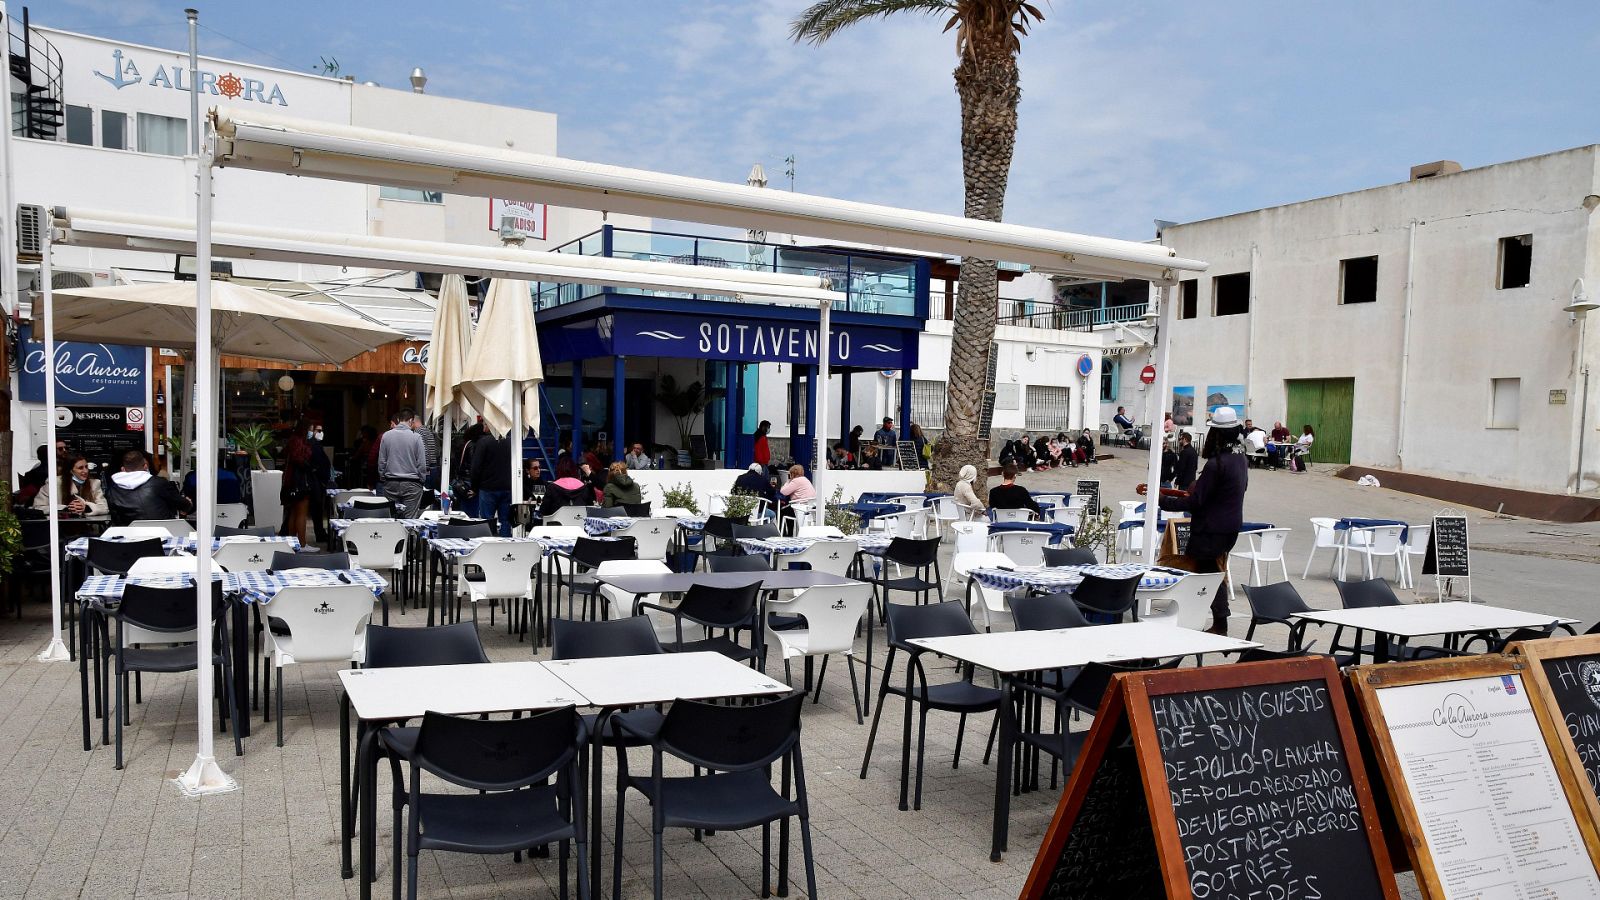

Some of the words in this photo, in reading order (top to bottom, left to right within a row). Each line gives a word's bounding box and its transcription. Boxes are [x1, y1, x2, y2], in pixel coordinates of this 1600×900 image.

[514, 217, 535, 232] ADISO
[75, 352, 141, 377] Aurora
[75, 411, 120, 420] NESPRESSO
[1152, 685, 1325, 726] HAMBURGUESAS
[1457, 705, 1489, 724] Aurora
